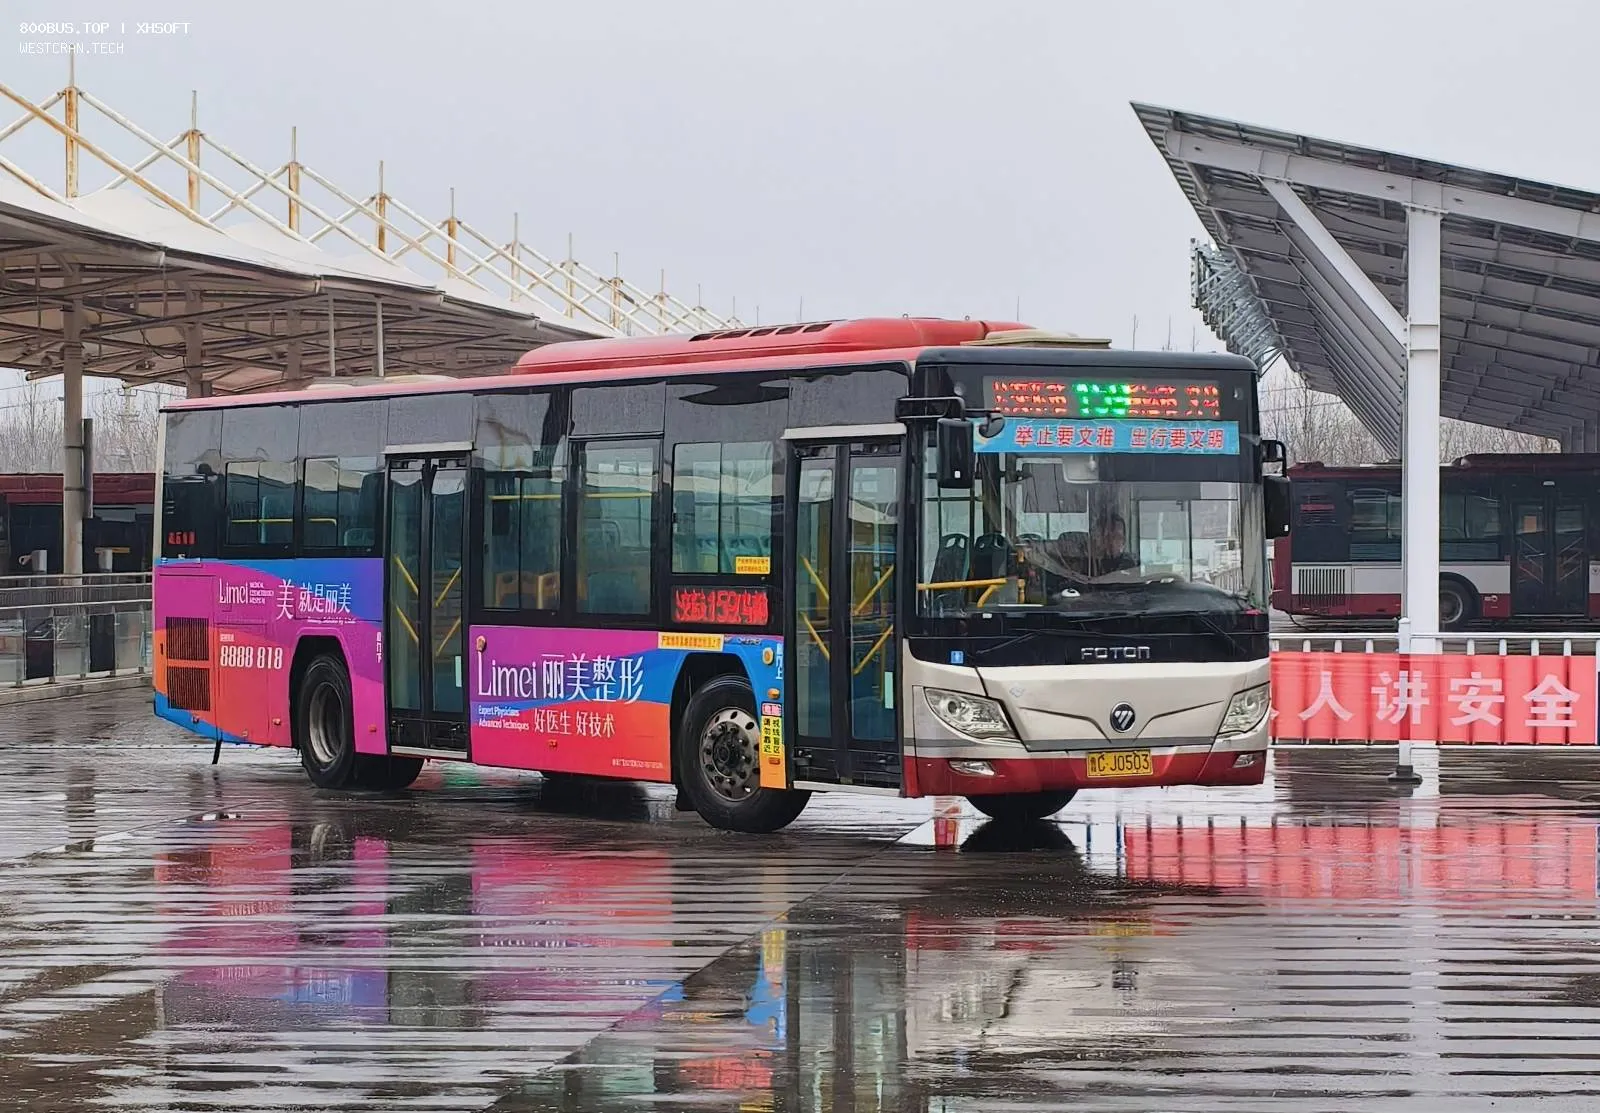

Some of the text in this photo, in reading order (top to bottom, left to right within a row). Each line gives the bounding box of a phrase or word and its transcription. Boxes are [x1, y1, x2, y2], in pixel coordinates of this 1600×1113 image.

[1015, 426, 1224, 449] 举止要文雅 出行要文明
[219, 578, 249, 604] Limei
[220, 645, 283, 669] 8888 818
[1081, 646, 1151, 661] FOTON
[478, 652, 645, 704] Limei 丽美整形
[1270, 671, 1581, 728] 人讲安全
[534, 708, 615, 738] 好医生 好技术
